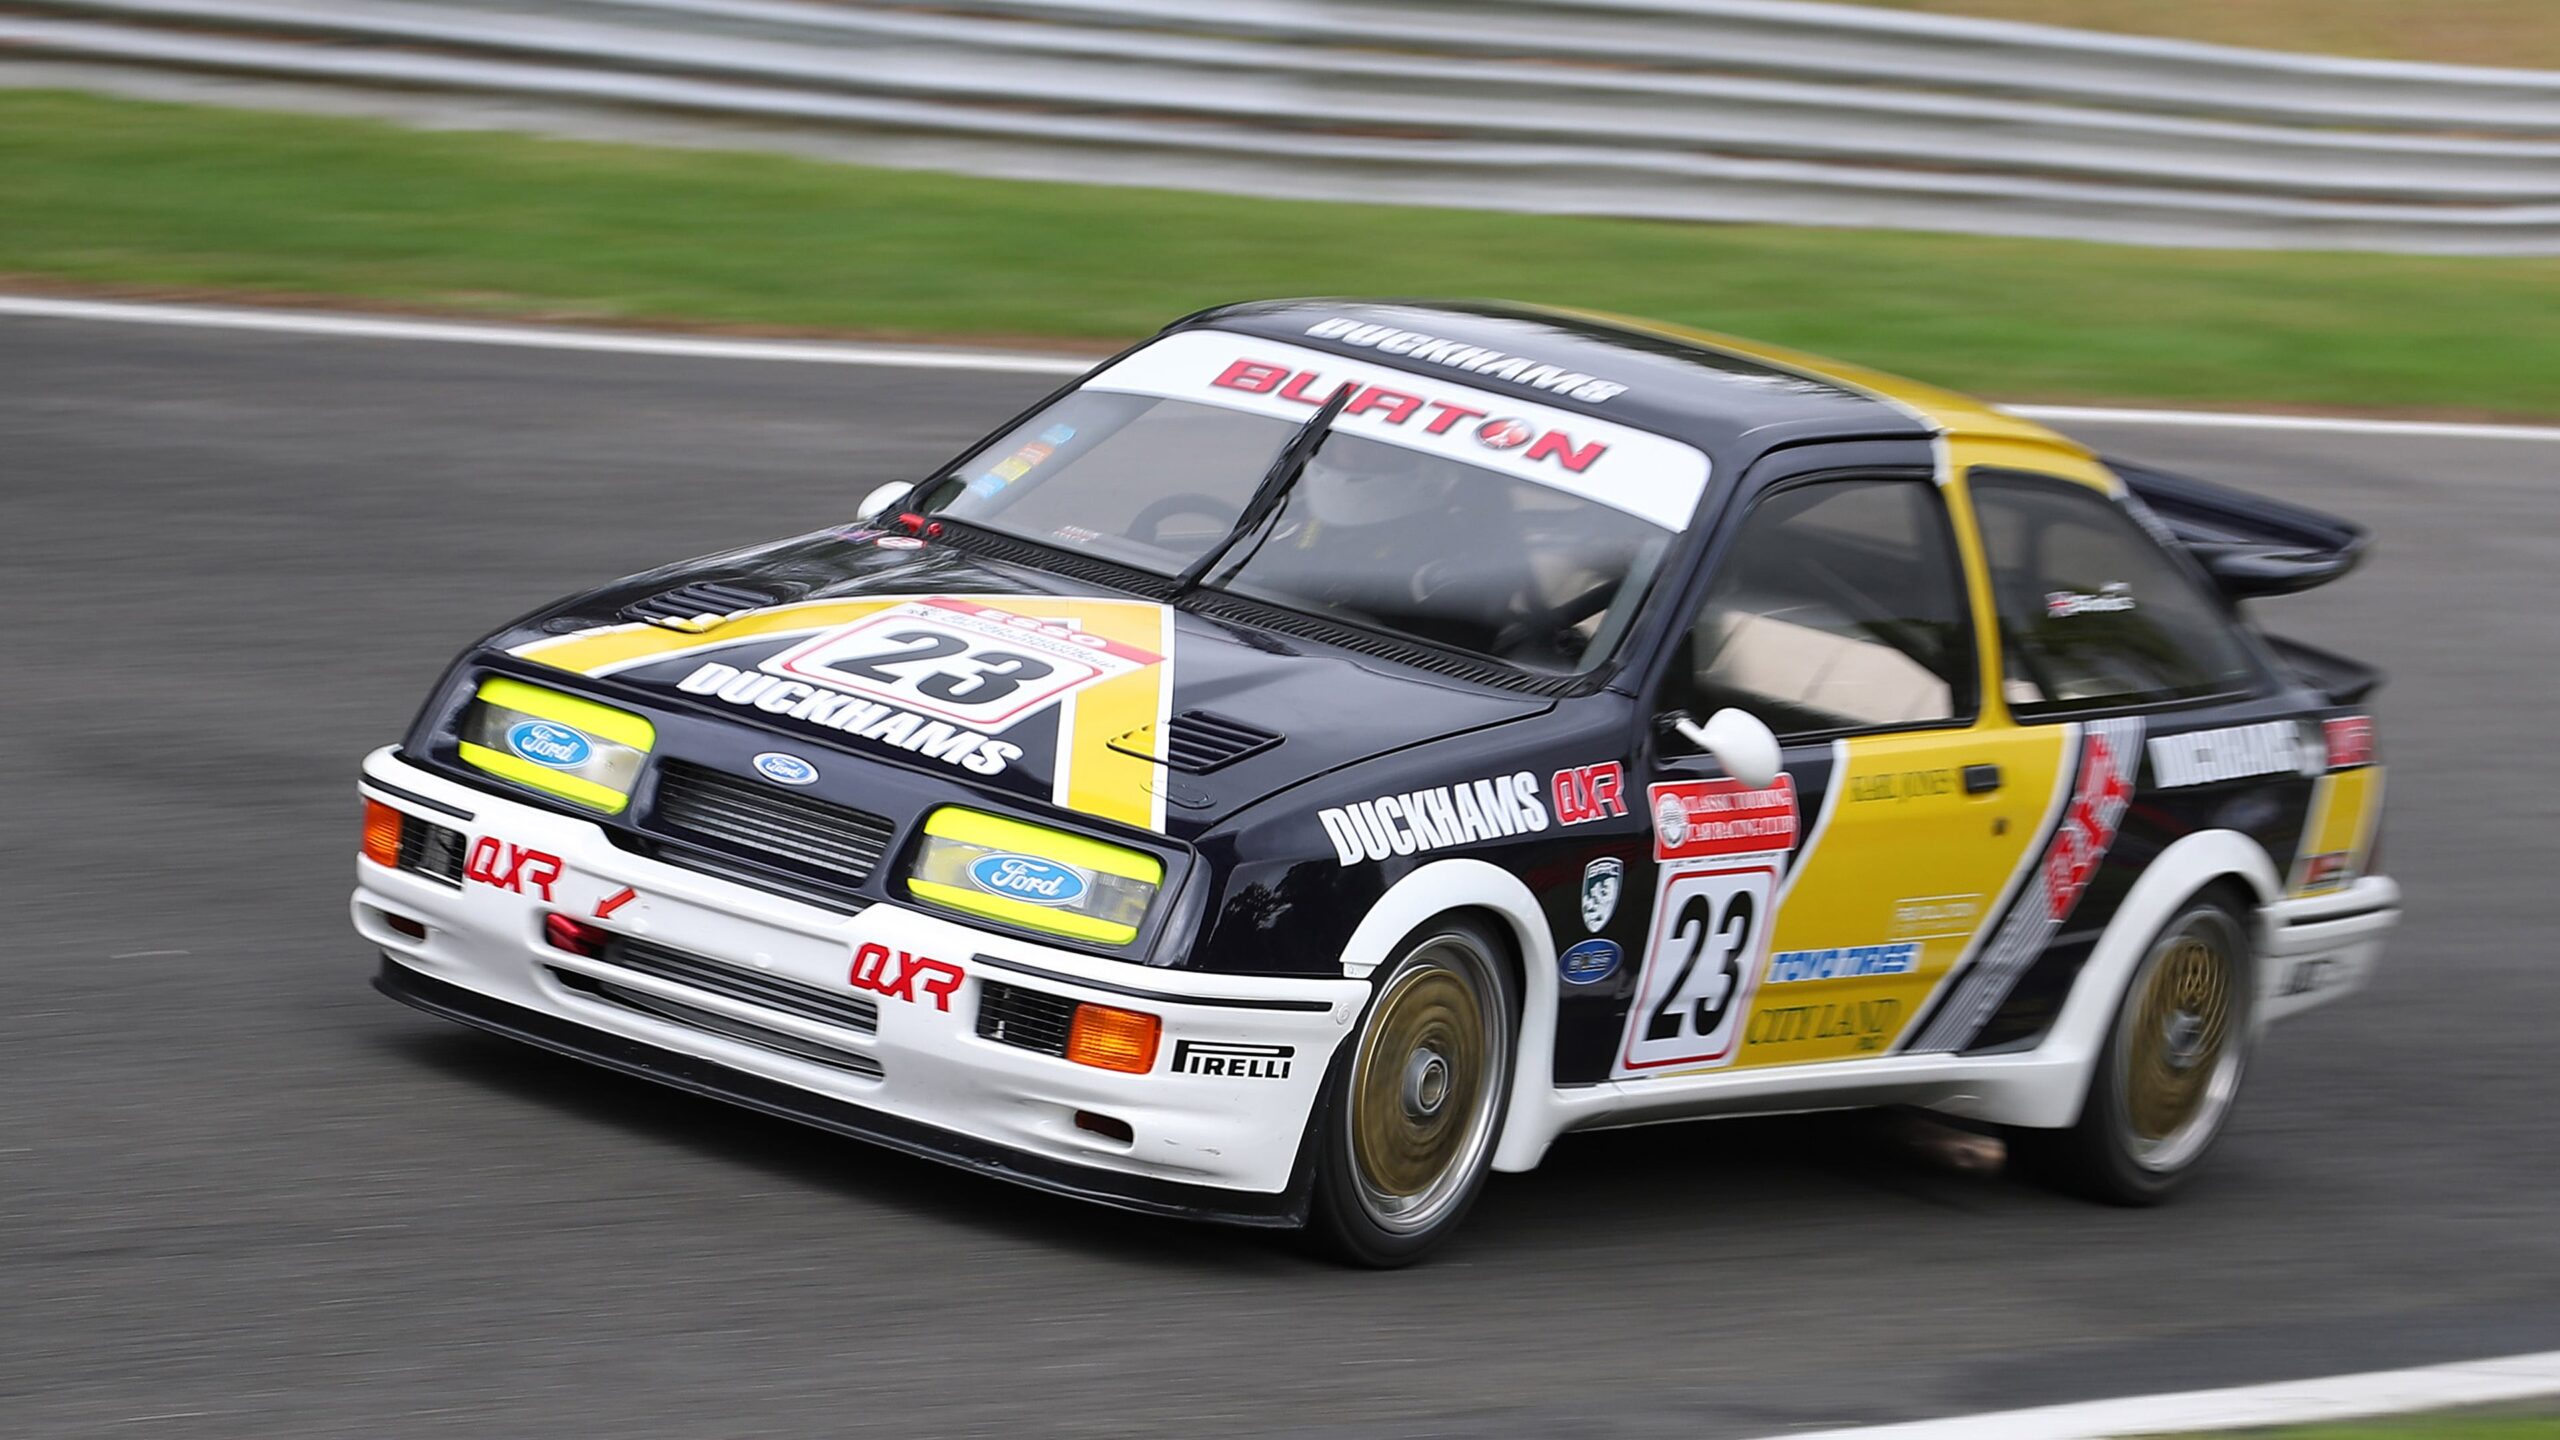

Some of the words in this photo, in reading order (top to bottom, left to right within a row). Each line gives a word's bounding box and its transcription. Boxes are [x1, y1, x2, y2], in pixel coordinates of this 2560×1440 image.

[1306, 317, 1629, 403] DUCKHAMS
[1209, 358, 1609, 474] BURTON
[828, 629, 1055, 704] 23
[521, 725, 580, 762] Ford
[676, 662, 1024, 776] DUCKHAMS
[1318, 770, 1550, 867] DUCKHAMS
[1552, 761, 1630, 826] QXR
[466, 836, 563, 902] QXR
[988, 857, 1060, 898] Ford
[849, 942, 965, 1012] QXR
[1643, 890, 1754, 1042] 23
[1769, 951, 1837, 982] TOYO
[1837, 943, 1917, 977] TIRES
[1171, 1039, 1295, 1079] PIRELLI
